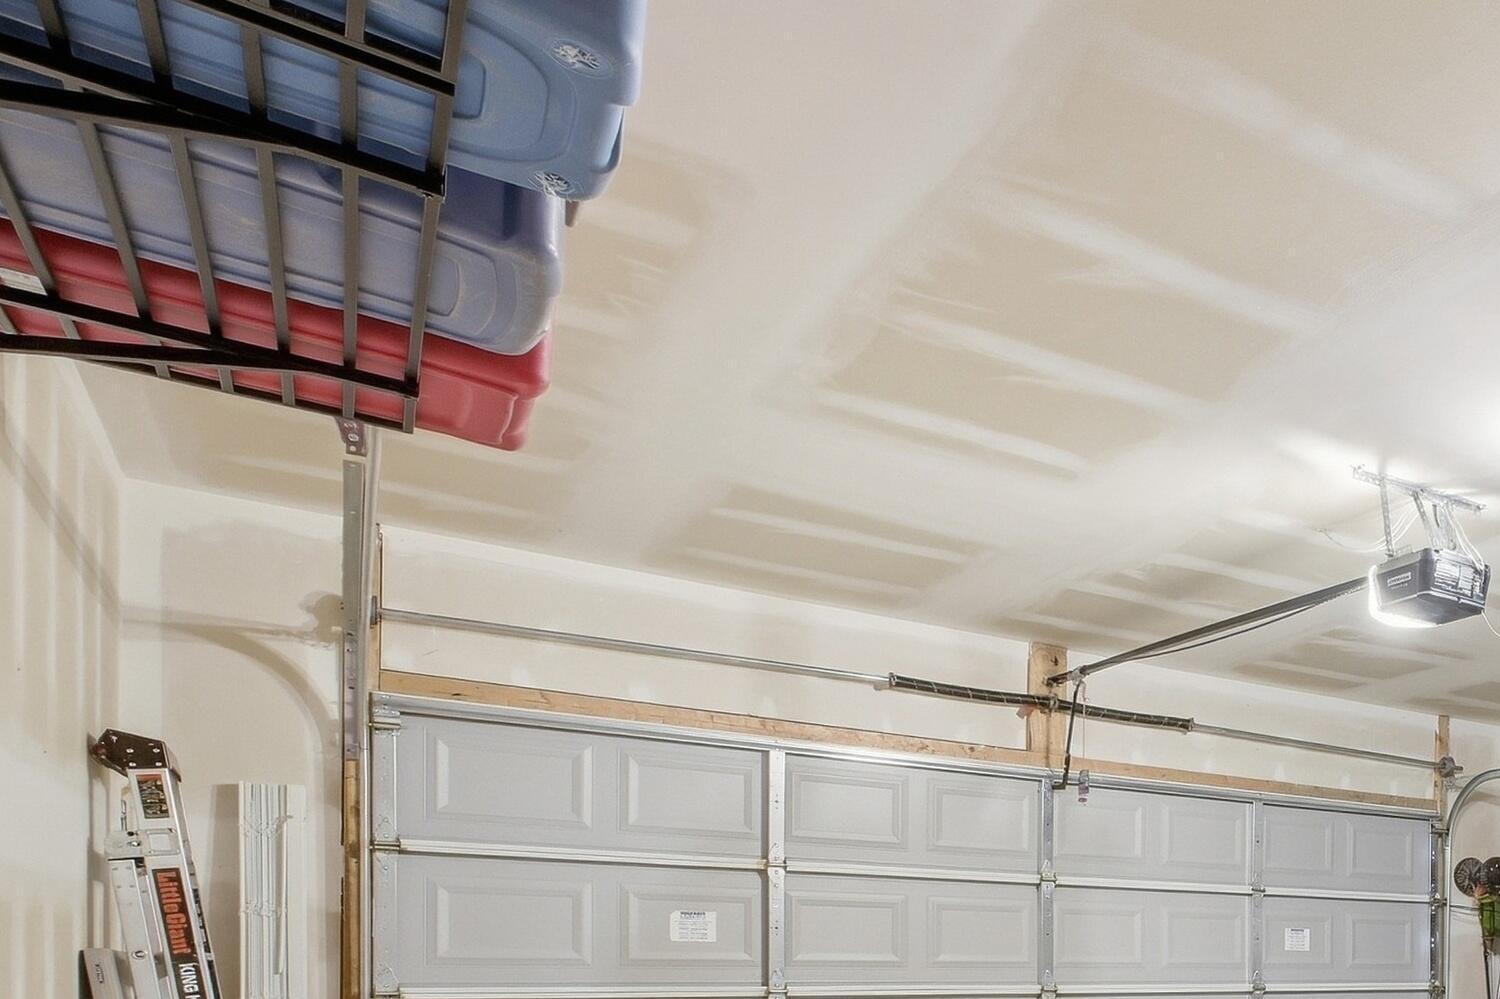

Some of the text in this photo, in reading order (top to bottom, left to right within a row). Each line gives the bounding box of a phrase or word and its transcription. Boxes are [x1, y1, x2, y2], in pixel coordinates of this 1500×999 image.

[157, 871, 191, 954] Little Giant
[179, 963, 199, 993] KING
